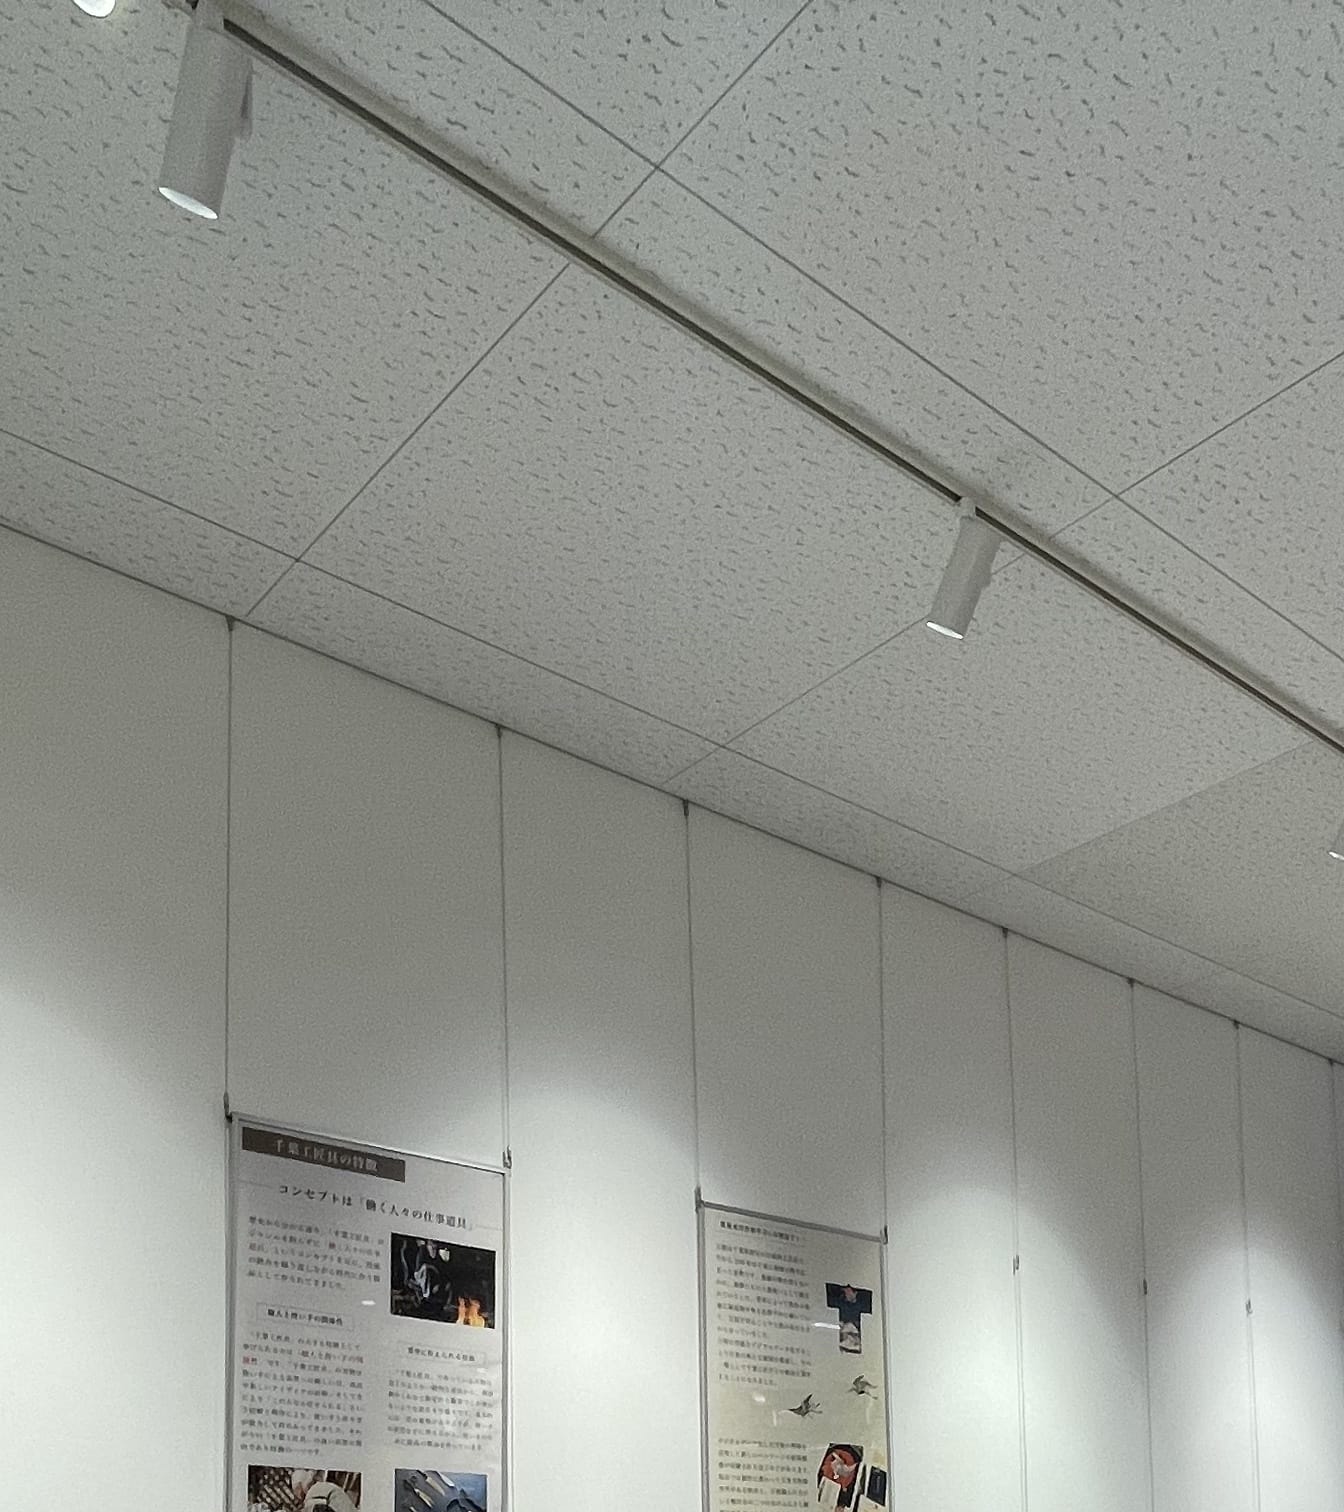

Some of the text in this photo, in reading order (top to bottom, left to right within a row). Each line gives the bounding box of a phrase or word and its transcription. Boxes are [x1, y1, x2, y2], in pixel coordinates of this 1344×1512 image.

[273, 1140, 377, 1171] 千葉工匠具の特徴
[278, 1183, 472, 1231] コンセプトは「働く人々の仕事道具」
